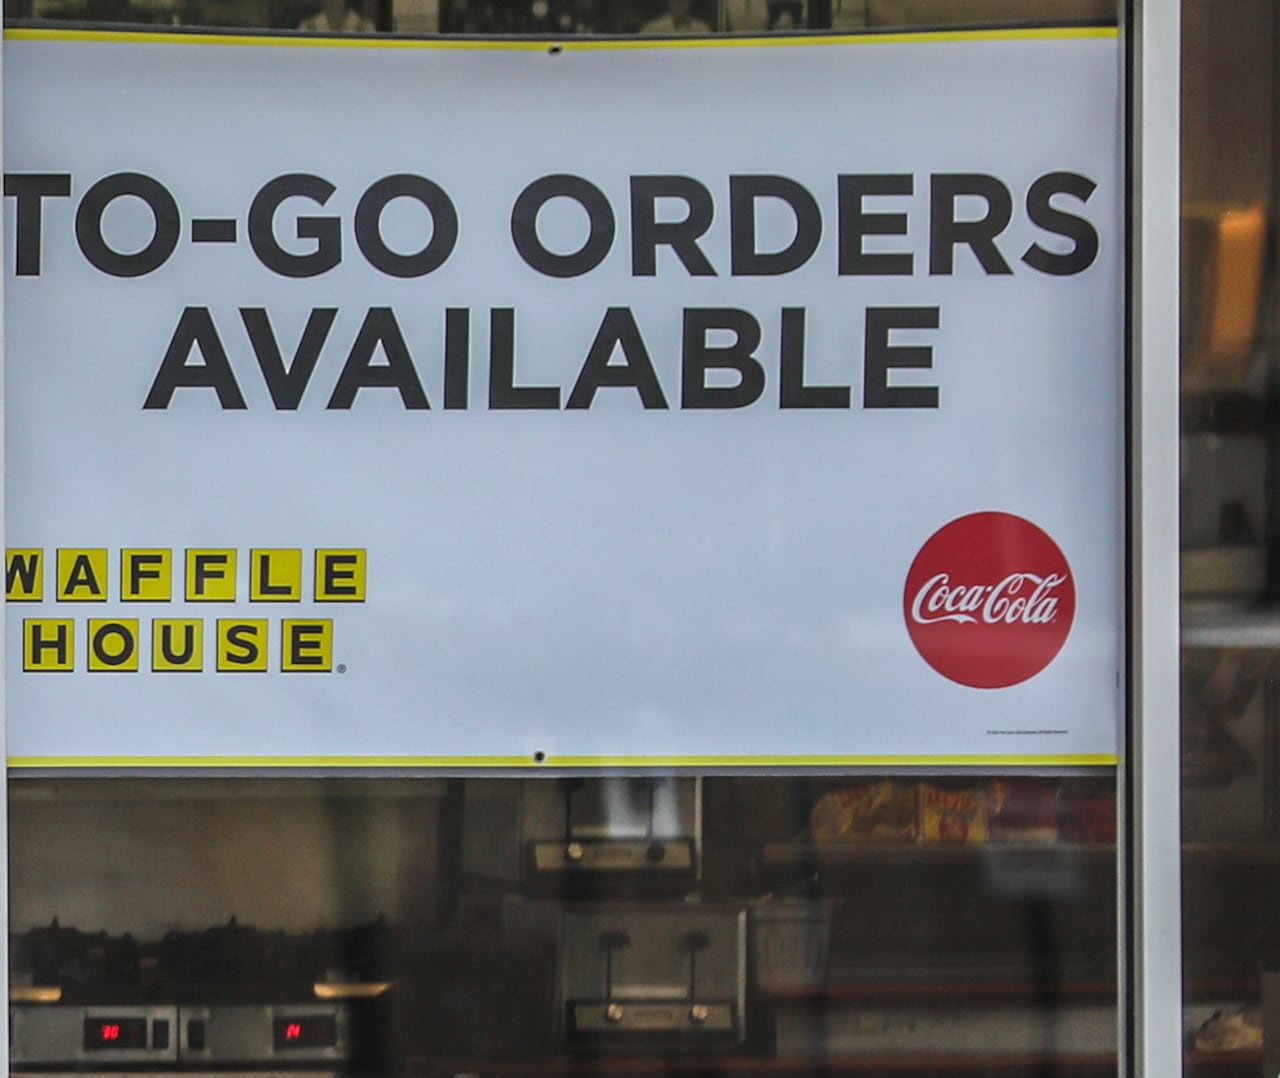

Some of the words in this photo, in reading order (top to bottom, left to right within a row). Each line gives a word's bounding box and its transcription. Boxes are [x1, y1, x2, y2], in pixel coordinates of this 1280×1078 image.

[3, 171, 460, 279] TO-GO
[509, 170, 1102, 279] ORDERS
[141, 305, 942, 412] AVAILABLE
[5, 550, 365, 600] WAFFLE
[912, 570, 1068, 626] Coca-Cola
[25, 620, 332, 671] HOUSE
